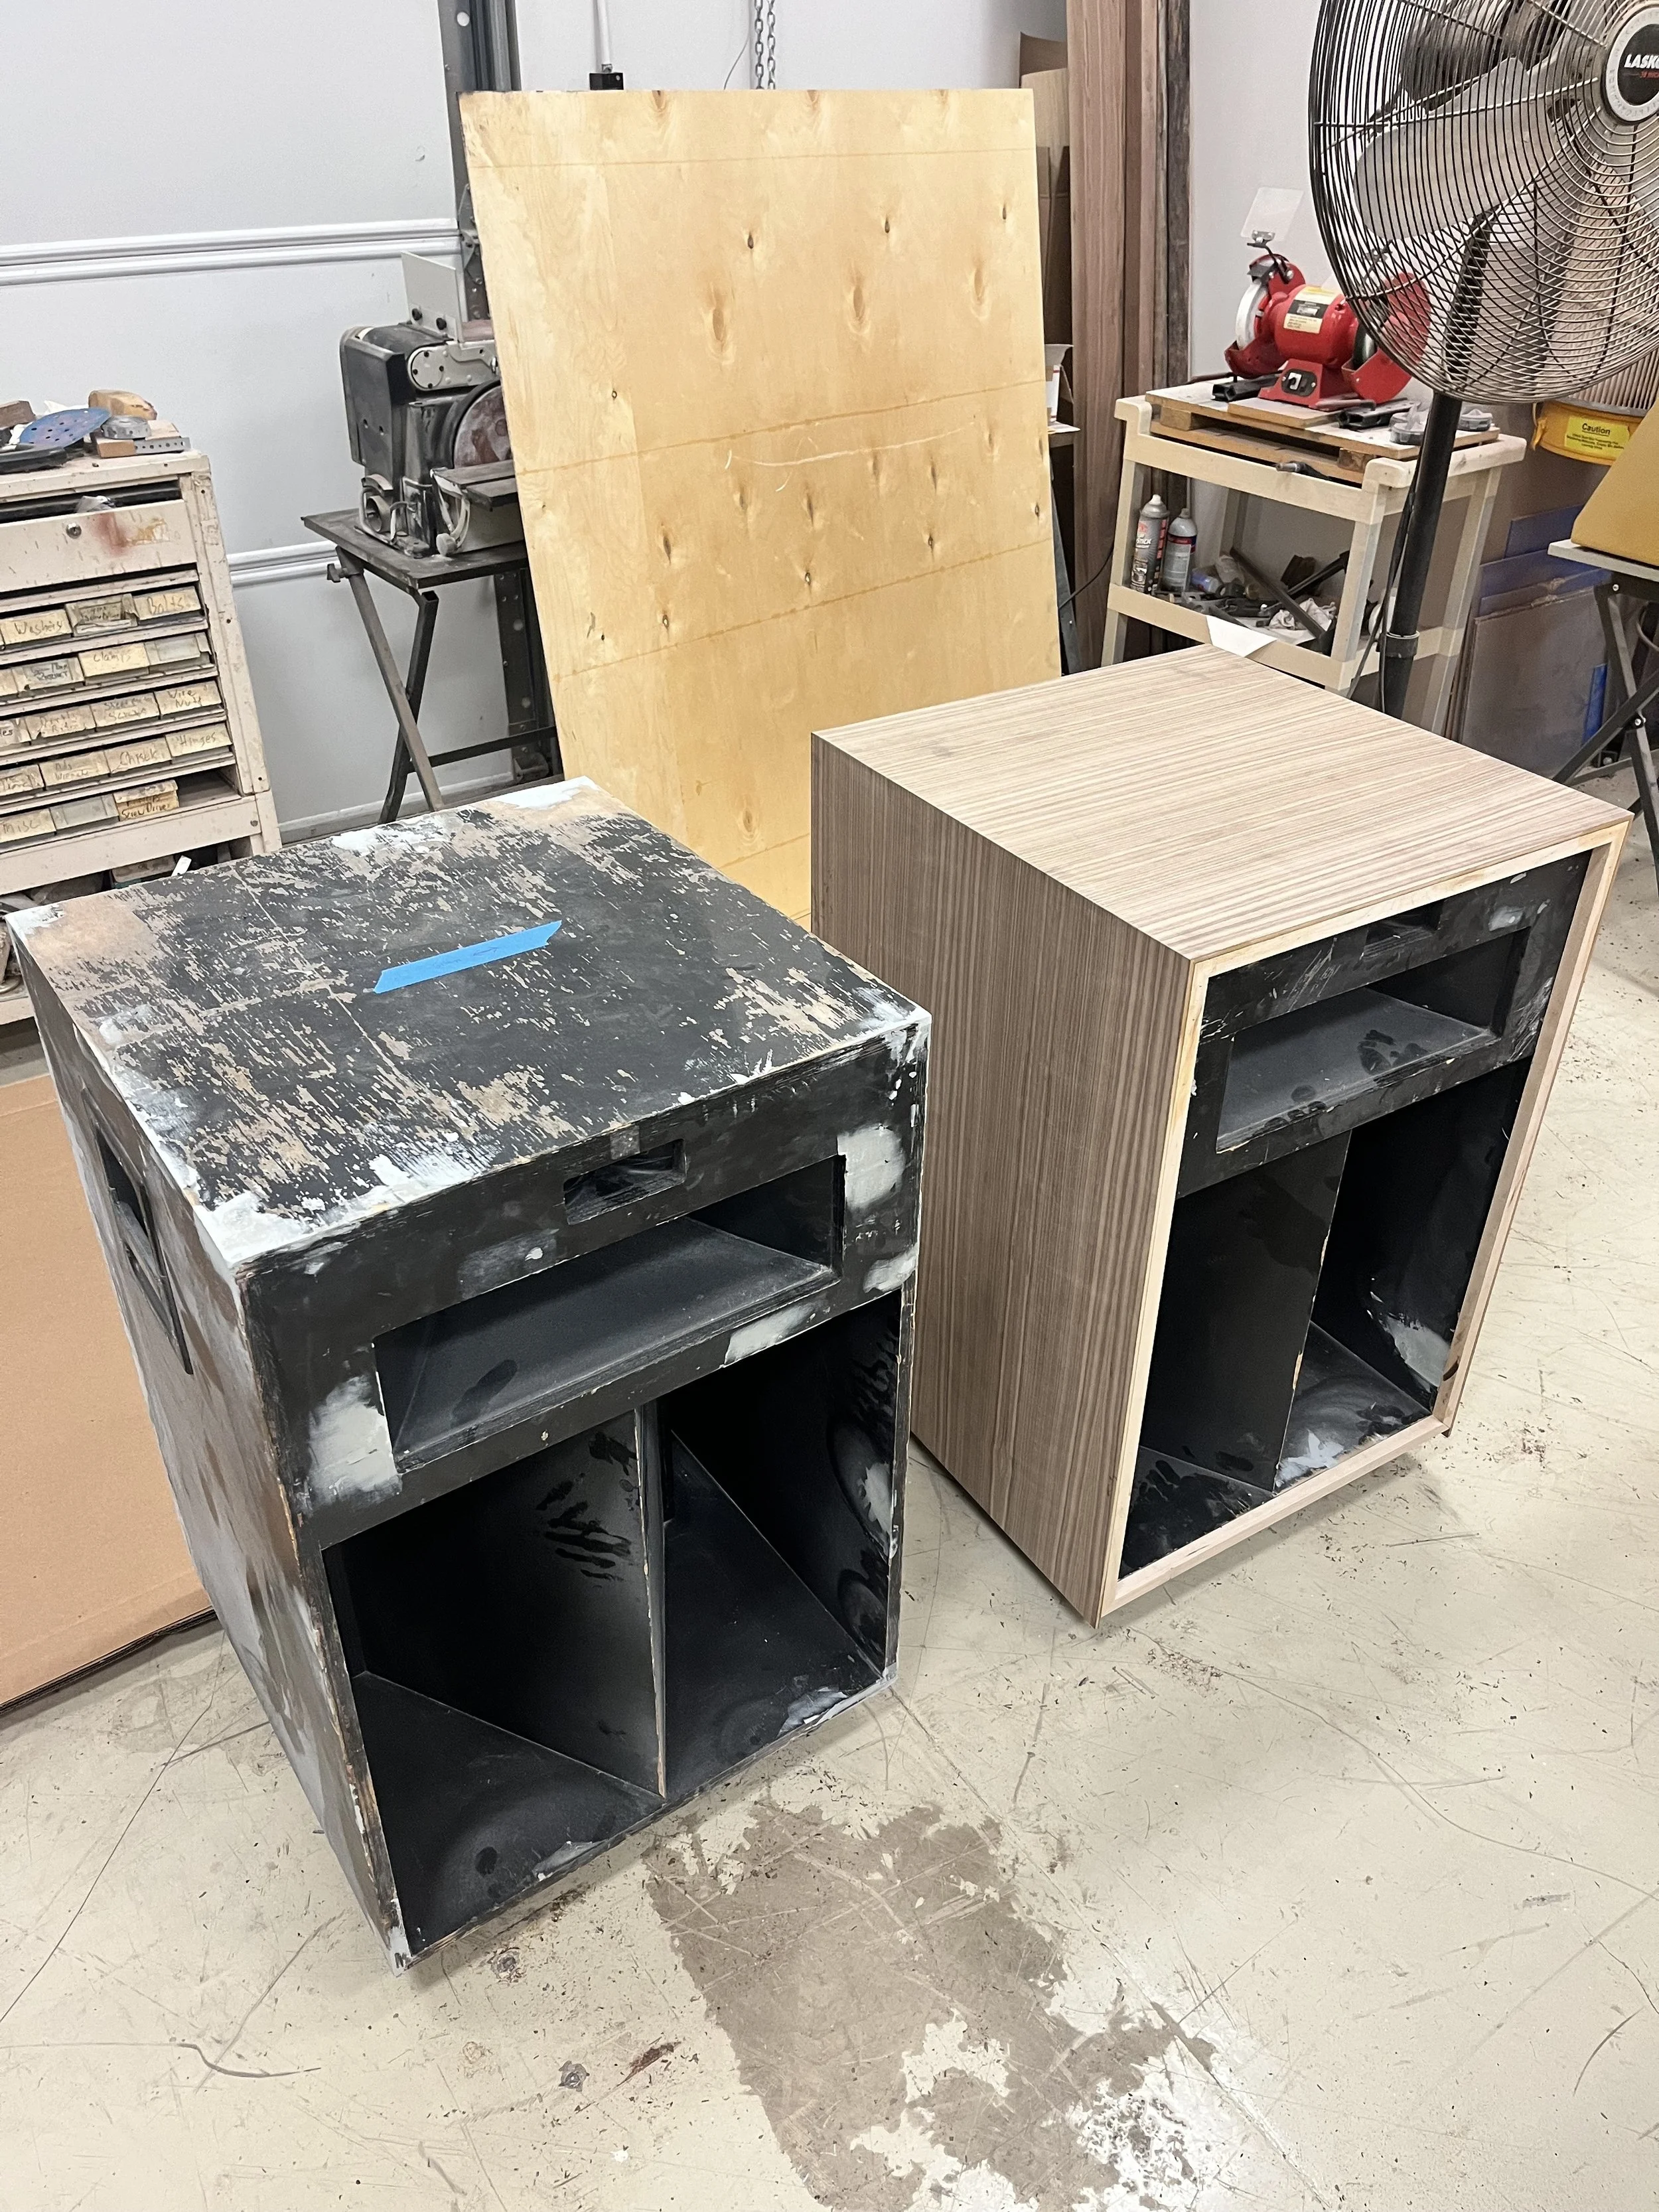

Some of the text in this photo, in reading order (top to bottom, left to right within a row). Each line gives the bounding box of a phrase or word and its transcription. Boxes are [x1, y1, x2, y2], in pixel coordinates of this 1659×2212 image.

[1582, 423, 1611, 435] Caution
[147, 595, 185, 615] Bolts
[167, 689, 196, 699] Wire
[179, 731, 216, 747] Hinges
